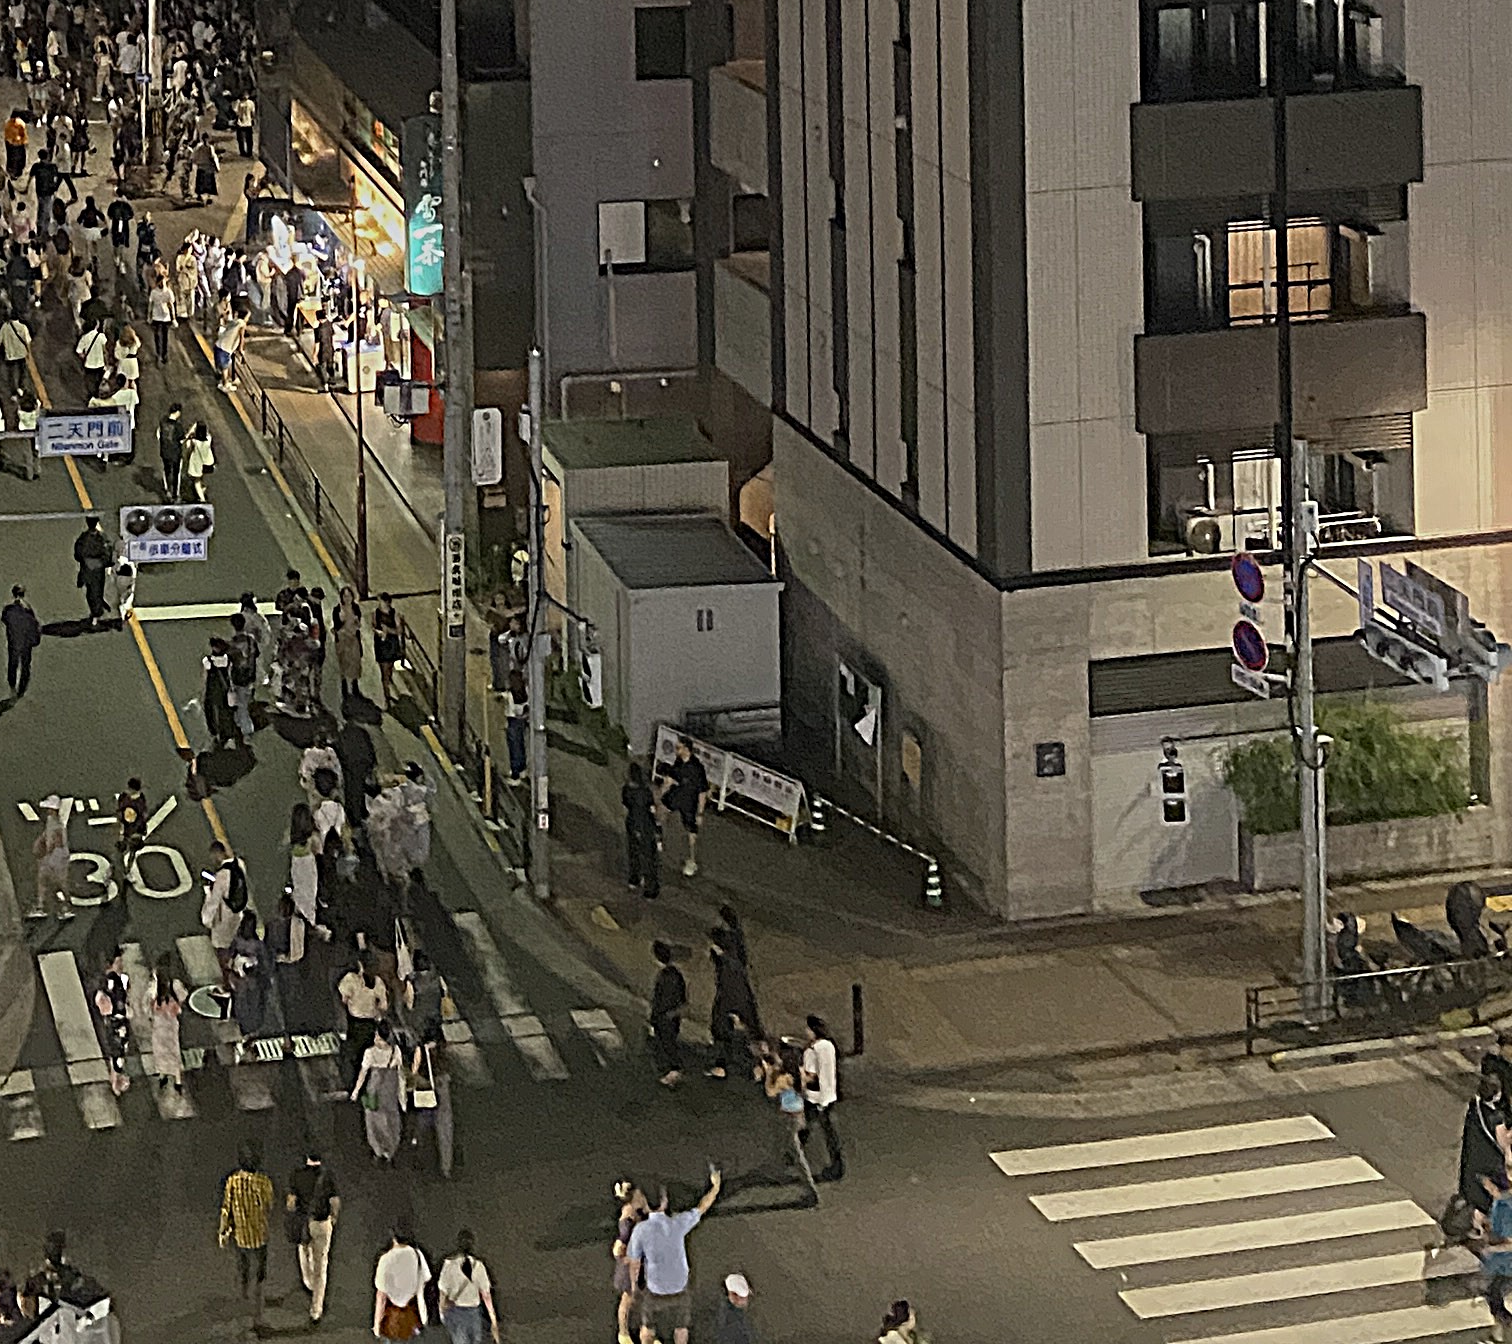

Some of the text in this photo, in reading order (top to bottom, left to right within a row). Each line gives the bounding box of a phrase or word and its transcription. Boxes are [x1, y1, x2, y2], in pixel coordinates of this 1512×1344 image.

[47, 419, 124, 440] 二天門前
[69, 845, 193, 907] 30
